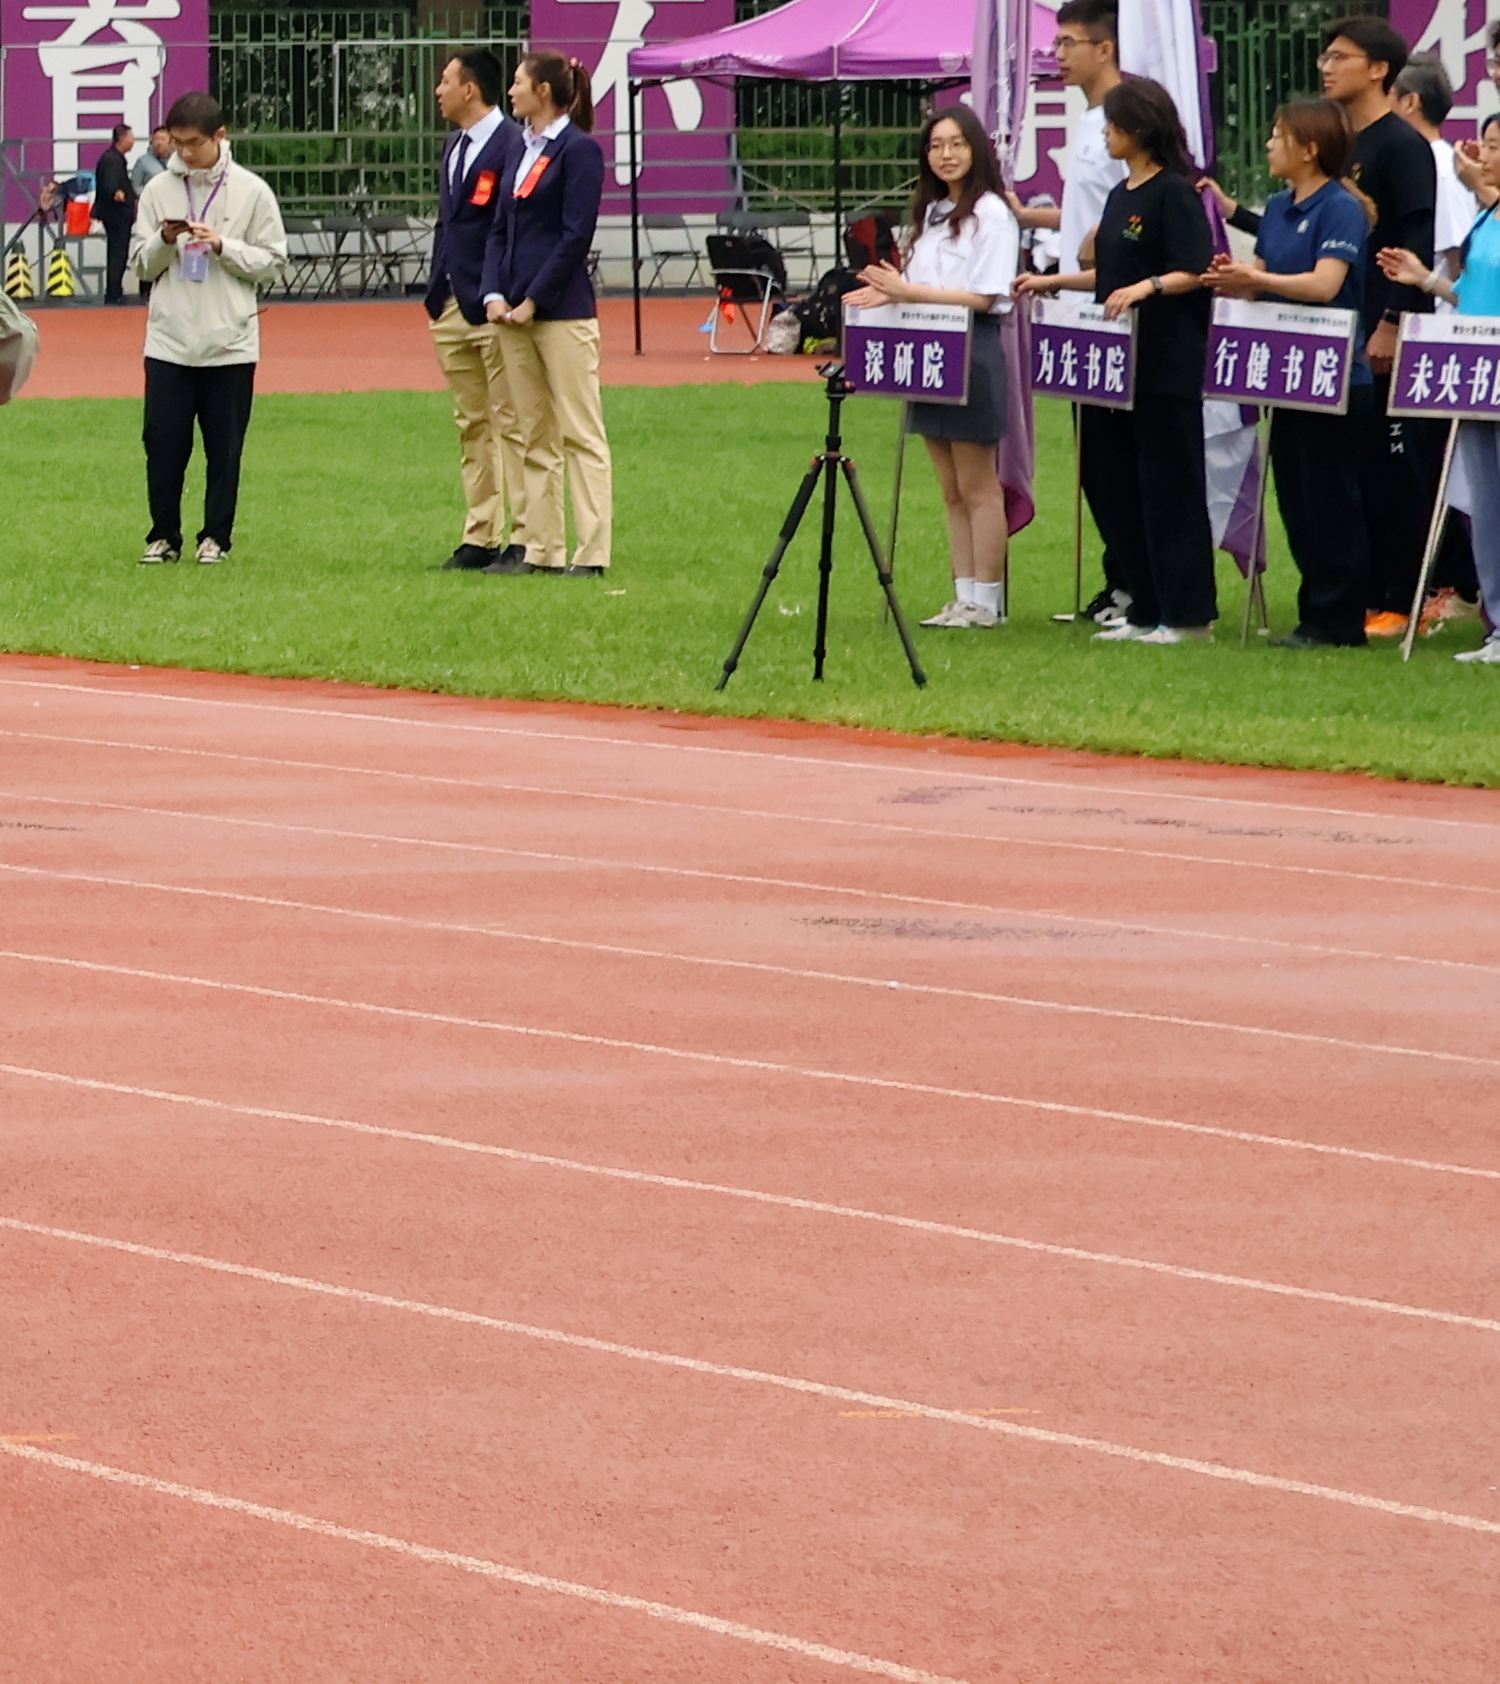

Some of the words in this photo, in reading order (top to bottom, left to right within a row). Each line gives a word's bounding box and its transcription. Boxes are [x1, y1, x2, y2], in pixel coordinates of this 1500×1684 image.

[863, 338, 946, 390] 深研院
[1035, 337, 1127, 394] 为先书院
[1213, 336, 1340, 399] 行健书院
